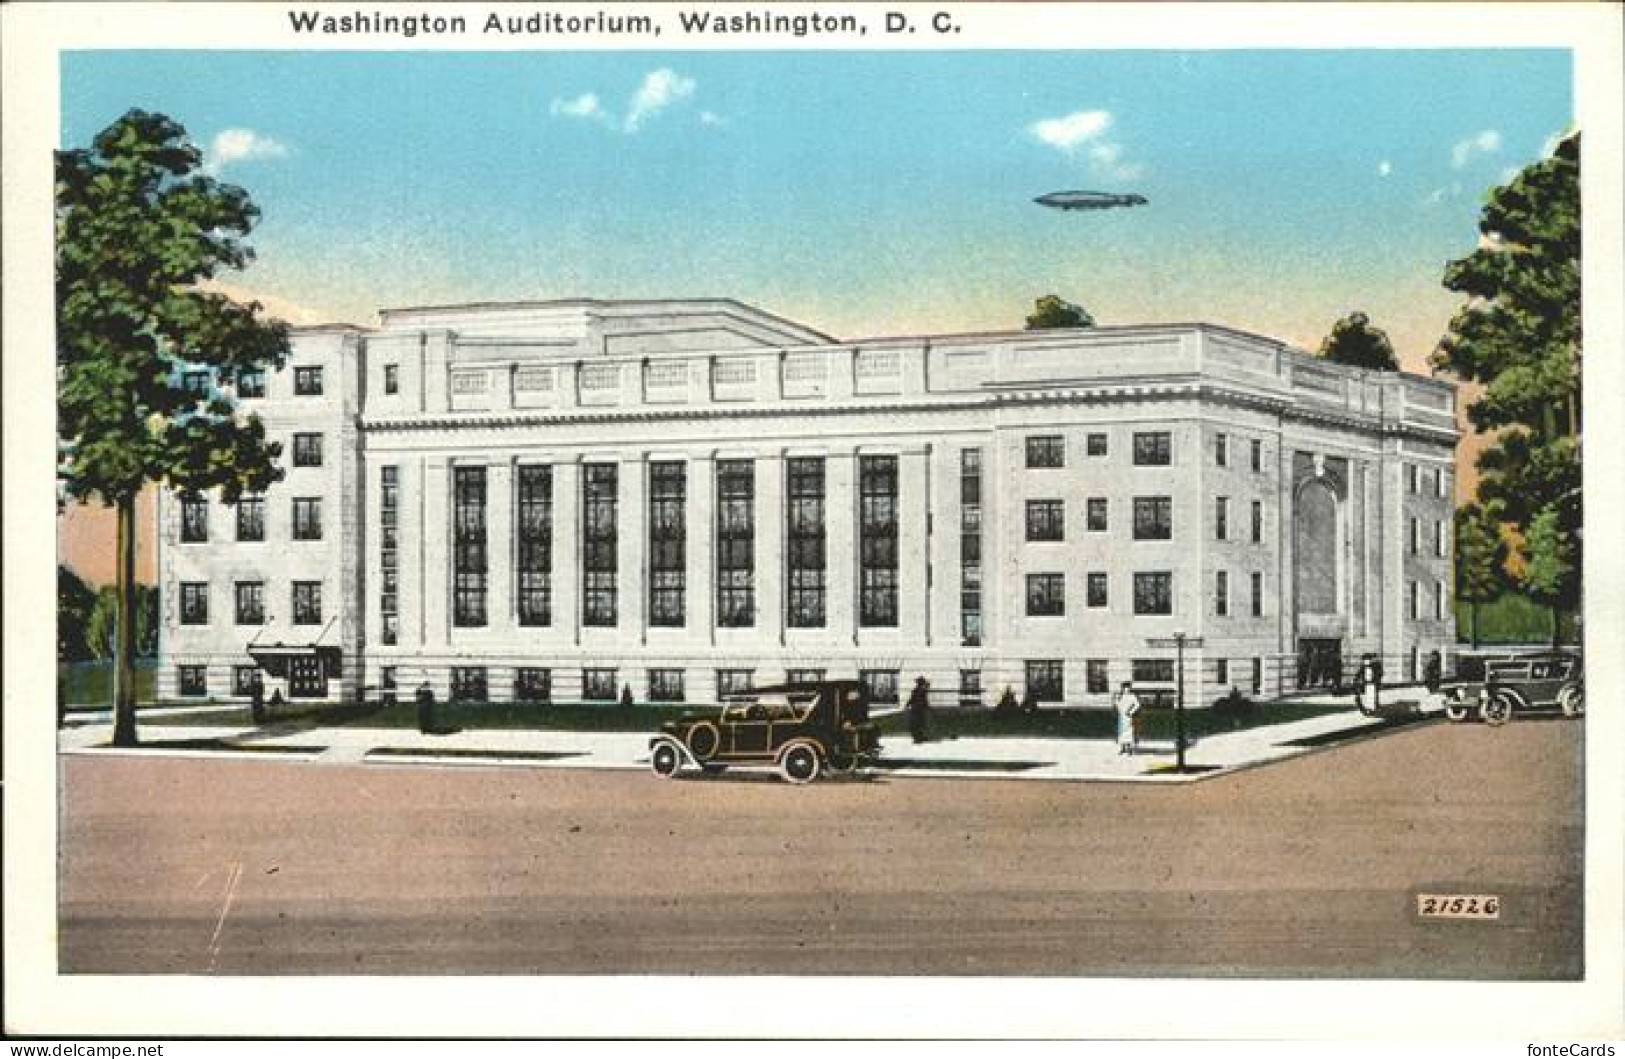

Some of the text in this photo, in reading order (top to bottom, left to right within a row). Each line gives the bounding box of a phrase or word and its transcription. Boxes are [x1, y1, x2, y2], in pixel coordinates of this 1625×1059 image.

[288, 11, 962, 37] Washington Auditorium, Washington, D. C.
[1422, 898, 1498, 915] 21526
